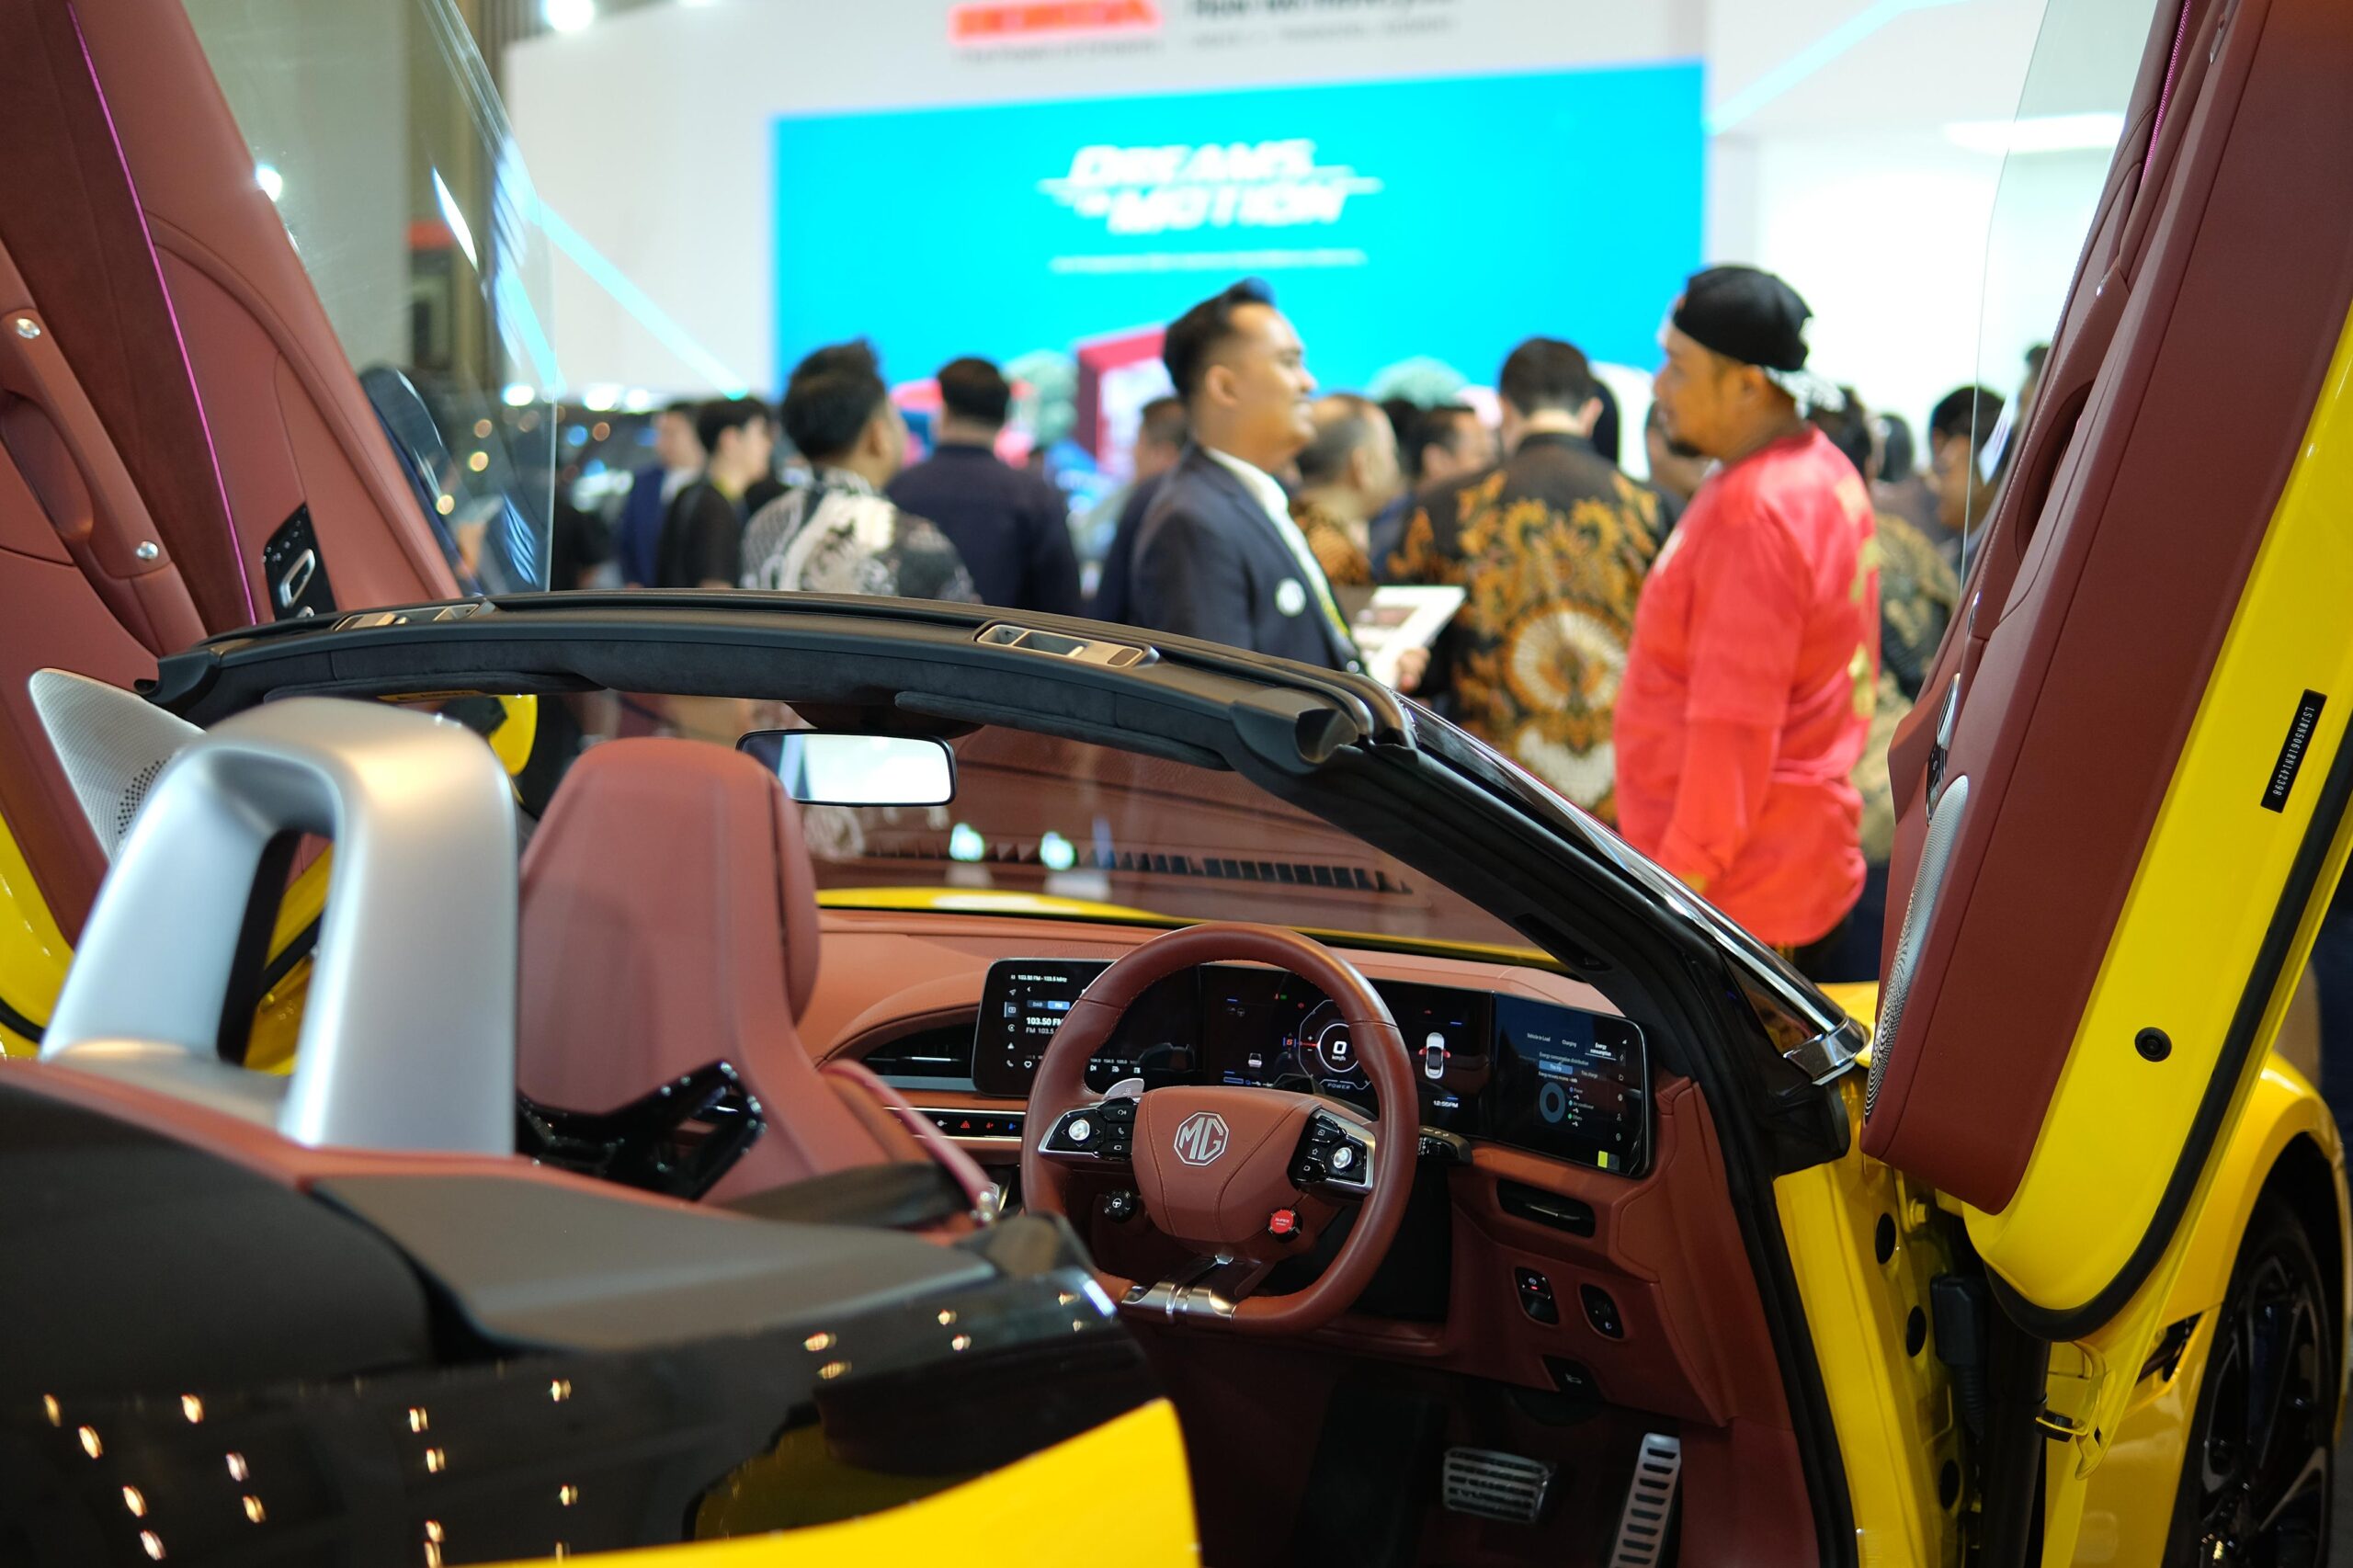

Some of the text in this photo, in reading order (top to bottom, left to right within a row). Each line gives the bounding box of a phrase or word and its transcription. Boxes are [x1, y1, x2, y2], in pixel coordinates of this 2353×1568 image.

[2273, 706, 2315, 796] LSJWN5061RN142398
[1026, 1017, 1051, 1026] 103.50
[1327, 1082, 1351, 1090] POWER
[1179, 1117, 1223, 1159] MG
